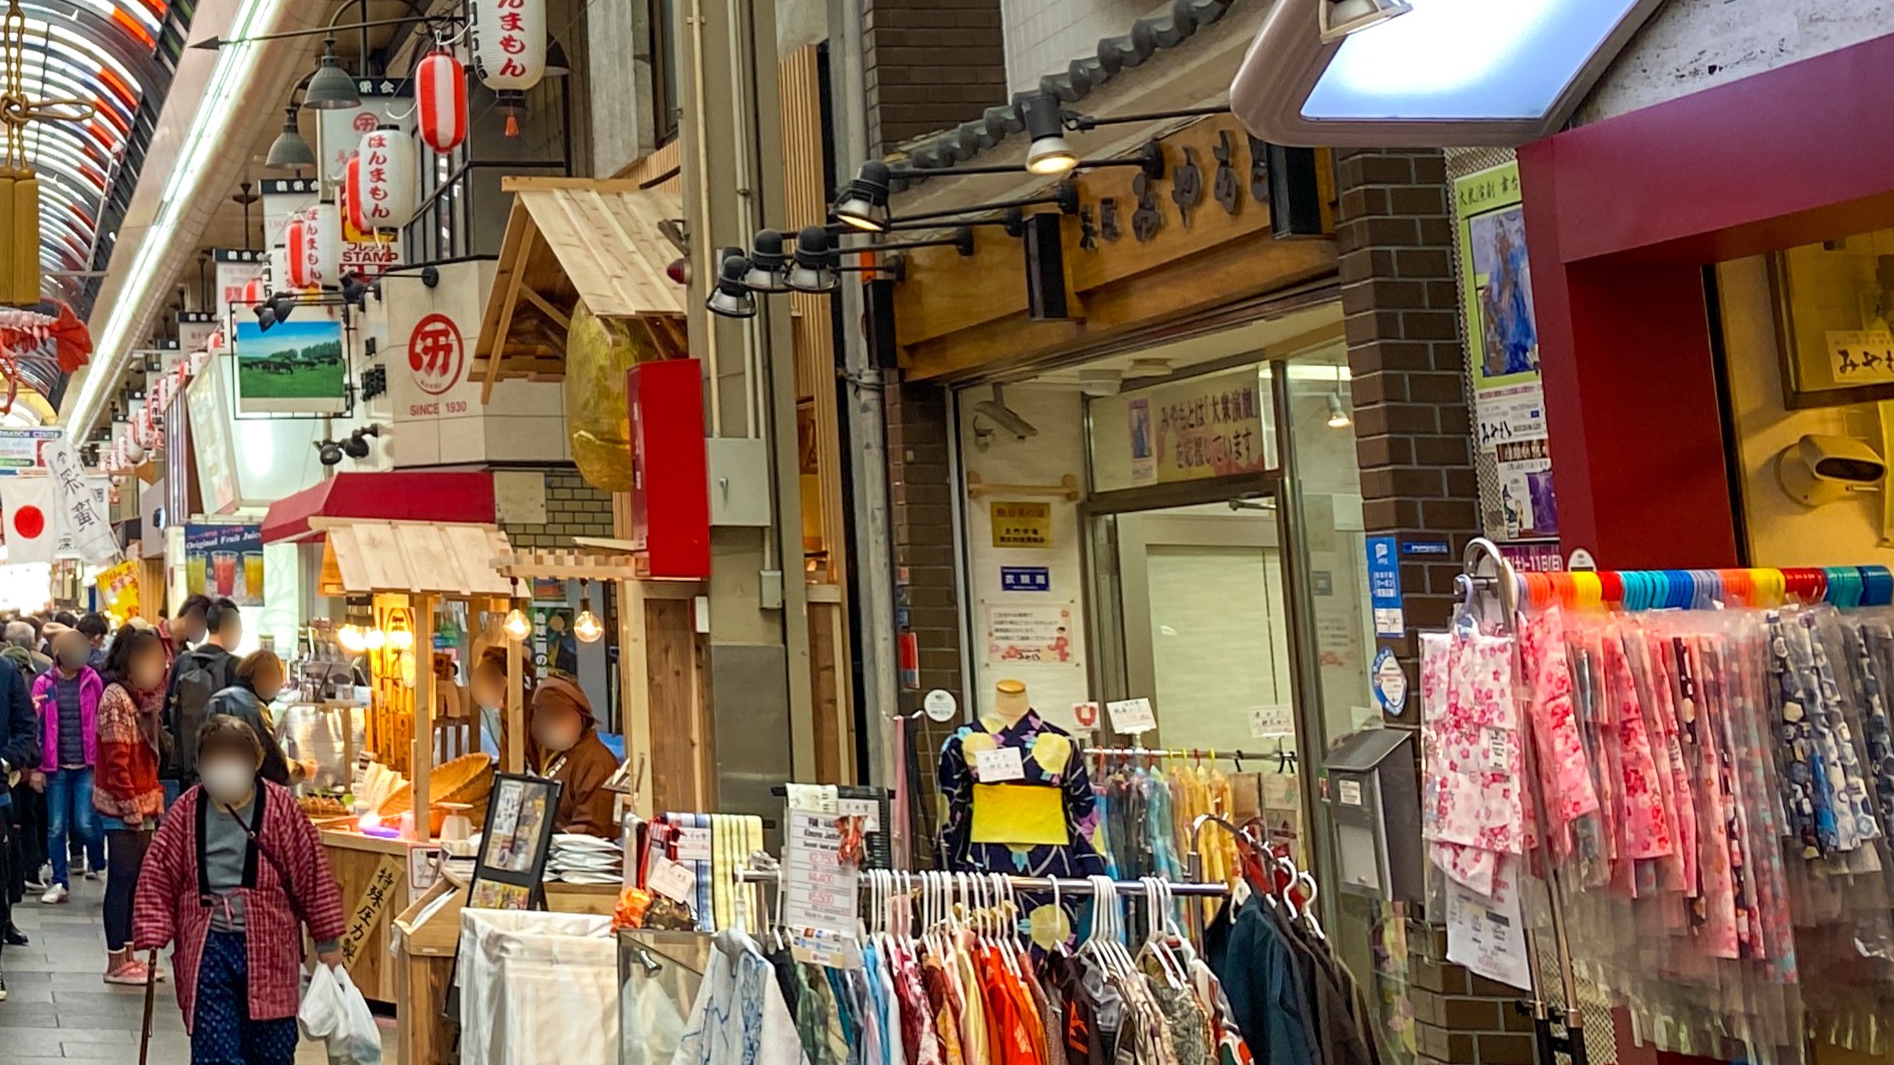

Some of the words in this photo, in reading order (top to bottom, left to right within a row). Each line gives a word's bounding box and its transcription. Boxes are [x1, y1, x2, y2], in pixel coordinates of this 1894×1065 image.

[358, 80, 395, 94] 栄会
[368, 134, 390, 219] ほんまもん
[409, 403, 440, 416] SINCE
[445, 400, 468, 414] 1930
[185, 538, 218, 551] Original
[220, 534, 240, 545] Fruit
[342, 867, 394, 964] 特殊圧力製
